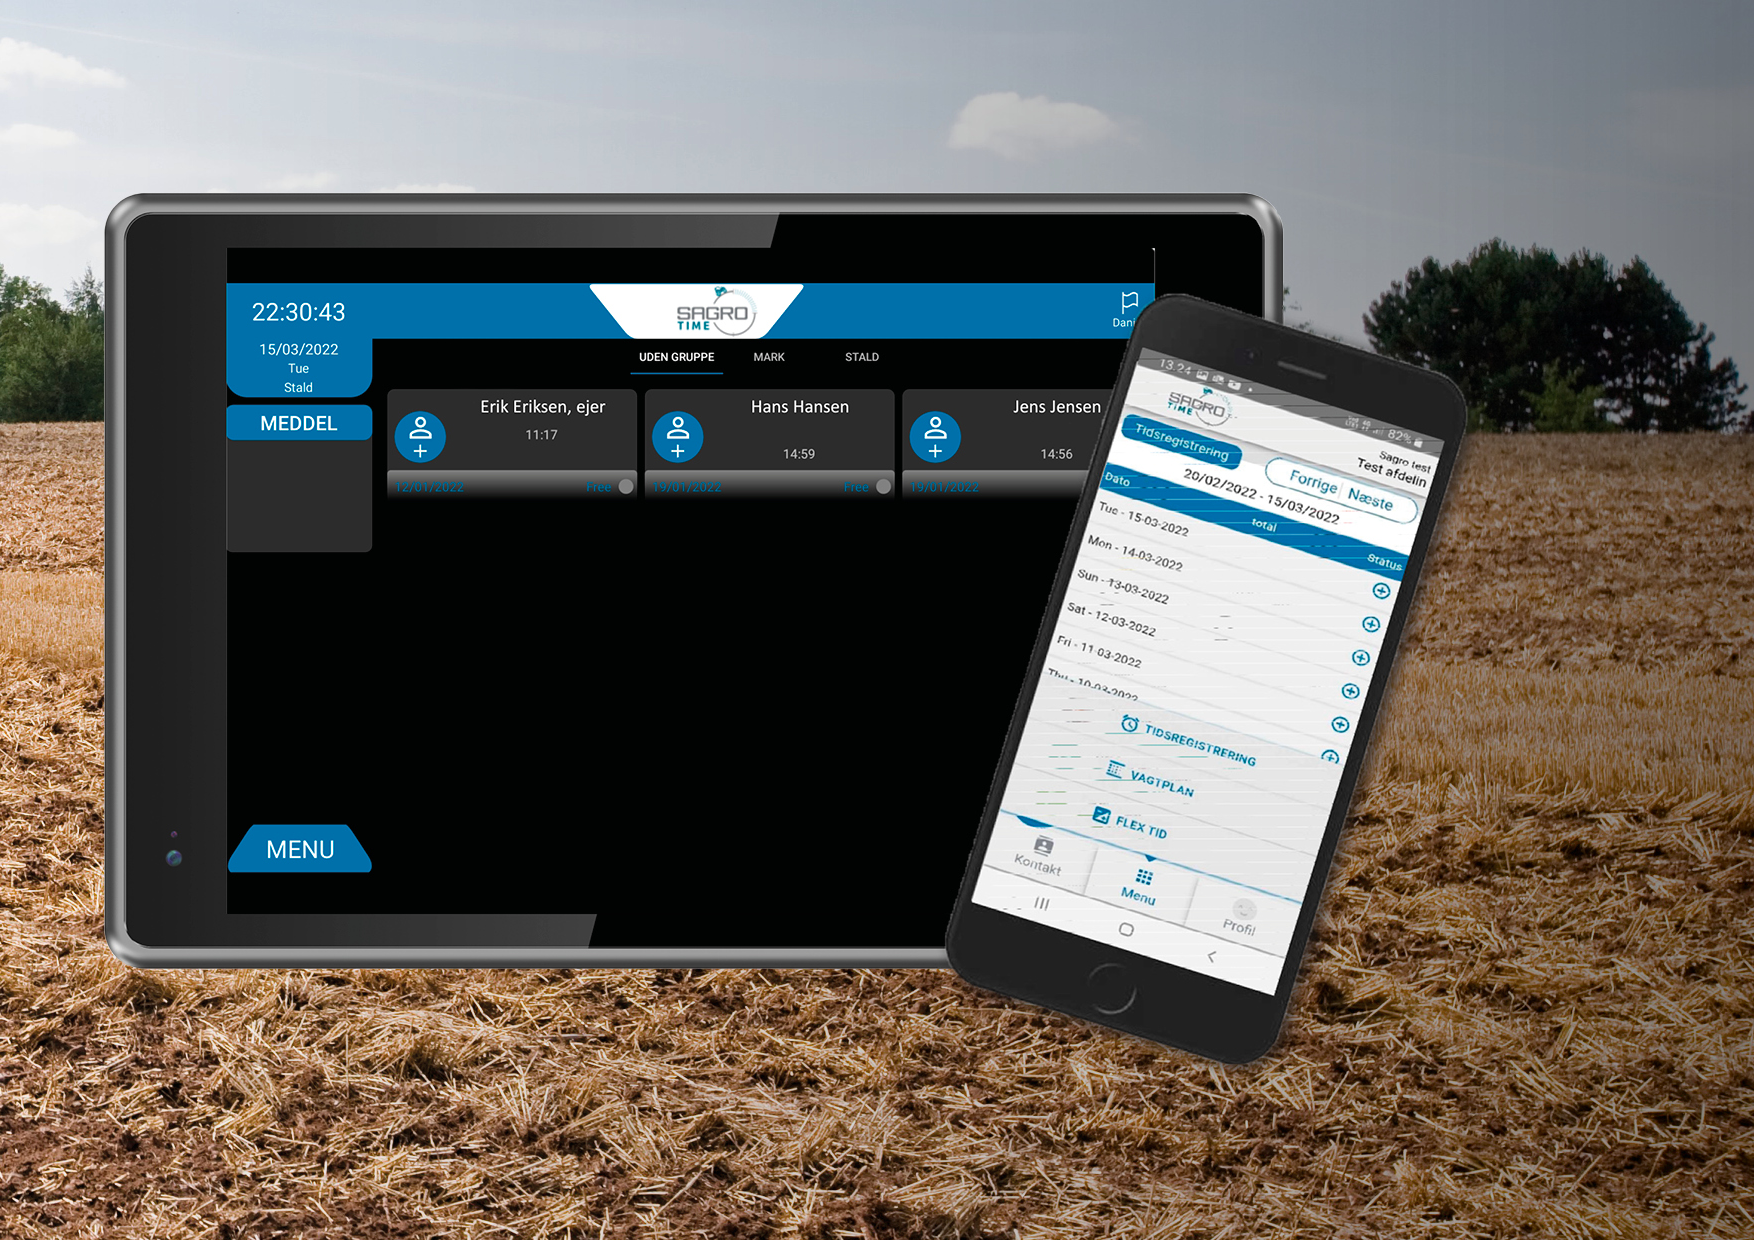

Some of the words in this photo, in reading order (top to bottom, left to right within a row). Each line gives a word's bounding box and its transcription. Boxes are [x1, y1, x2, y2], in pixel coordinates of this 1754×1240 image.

[252, 302, 346, 322] 22:30:43
[677, 306, 748, 321] SAGRO
[677, 321, 710, 331] TIME
[259, 343, 339, 357] 15/03/2022
[639, 352, 669, 362] UDEN
[671, 352, 715, 362] GRUPPE
[753, 352, 785, 362] MARK
[845, 352, 879, 362] STALD
[288, 363, 309, 375] Tue
[284, 382, 313, 394] Stald
[481, 399, 509, 414] Erik
[514, 399, 572, 417] Eriksen,
[576, 399, 606, 418] ejer
[751, 400, 789, 414] Hans
[793, 400, 849, 414] Hansen
[1013, 400, 1046, 414] Jens
[1049, 400, 1101, 414] Jensen
[1167, 402, 1193, 416] TIME
[1168, 391, 1226, 418] SAGRO
[260, 415, 338, 431] MEDDEL
[525, 429, 558, 441] 11:17
[1388, 429, 1412, 444] 82%
[1135, 423, 1230, 464] Tidsregistrering
[783, 448, 816, 460] 14:59
[1040, 448, 1073, 460] 14:56
[1379, 450, 1409, 466] Sagro
[1411, 460, 1431, 474] test
[1105, 471, 1131, 488] Dato
[1357, 457, 1384, 475] Test
[1385, 468, 1427, 488] afdelin
[395, 481, 464, 493] 12/01/2022
[586, 481, 611, 493] Free
[652, 481, 722, 493] 19/01/2022
[844, 481, 869, 493] Free
[910, 481, 979, 493] 19/01/2022
[1290, 469, 1338, 496] Forrige
[1184, 468, 1257, 500] 20/02/2022
[1267, 494, 1340, 526] 15/03/2022
[1347, 487, 1393, 513] Næste
[1099, 501, 1119, 516] Tue
[1128, 510, 1190, 538] 15-03-2022
[1251, 517, 1277, 533] total
[1088, 534, 1112, 551] Mon
[1122, 546, 1184, 573] 14-03-2022
[1367, 553, 1403, 572] Status
[1077, 568, 1100, 584] Sun
[1067, 602, 1087, 617] Sat
[1095, 610, 1157, 637] 12-03-2022
[1057, 635, 1073, 649] Fri
[1145, 724, 1257, 768] TIDSREGISTRERING
[1131, 770, 1195, 797] VAGTPLAN
[1116, 816, 1145, 833] FLEX
[1147, 825, 1168, 840] TID
[267, 840, 335, 859] MENU
[1014, 853, 1062, 877] Kontakt
[1121, 885, 1156, 907] Menu
[1223, 918, 1256, 937] Profil
